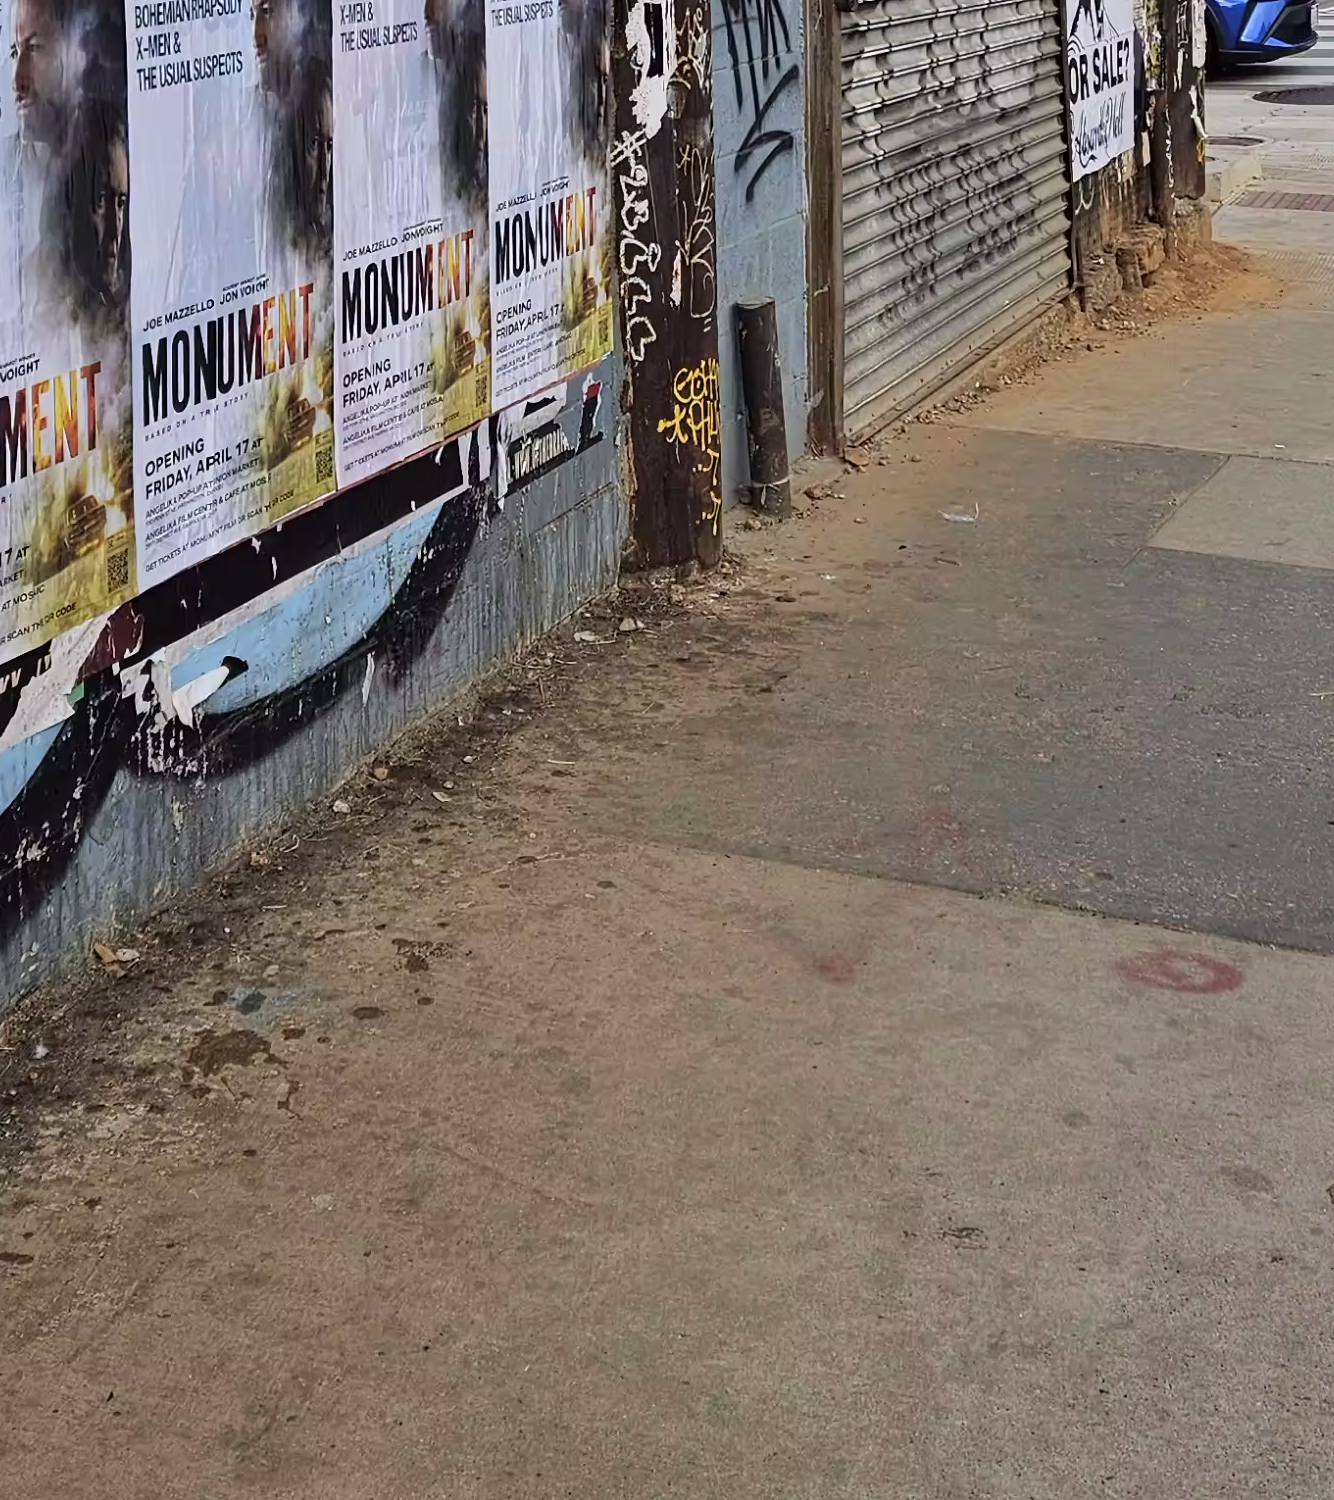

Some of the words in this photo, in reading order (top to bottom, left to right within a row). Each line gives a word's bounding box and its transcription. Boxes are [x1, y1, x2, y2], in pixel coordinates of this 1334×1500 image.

[1093, 37, 1130, 95] SALE?
[341, 230, 474, 344] MONUMENT
[494, 188, 597, 285] MONUMENT
[142, 283, 314, 427] MONUMENT
